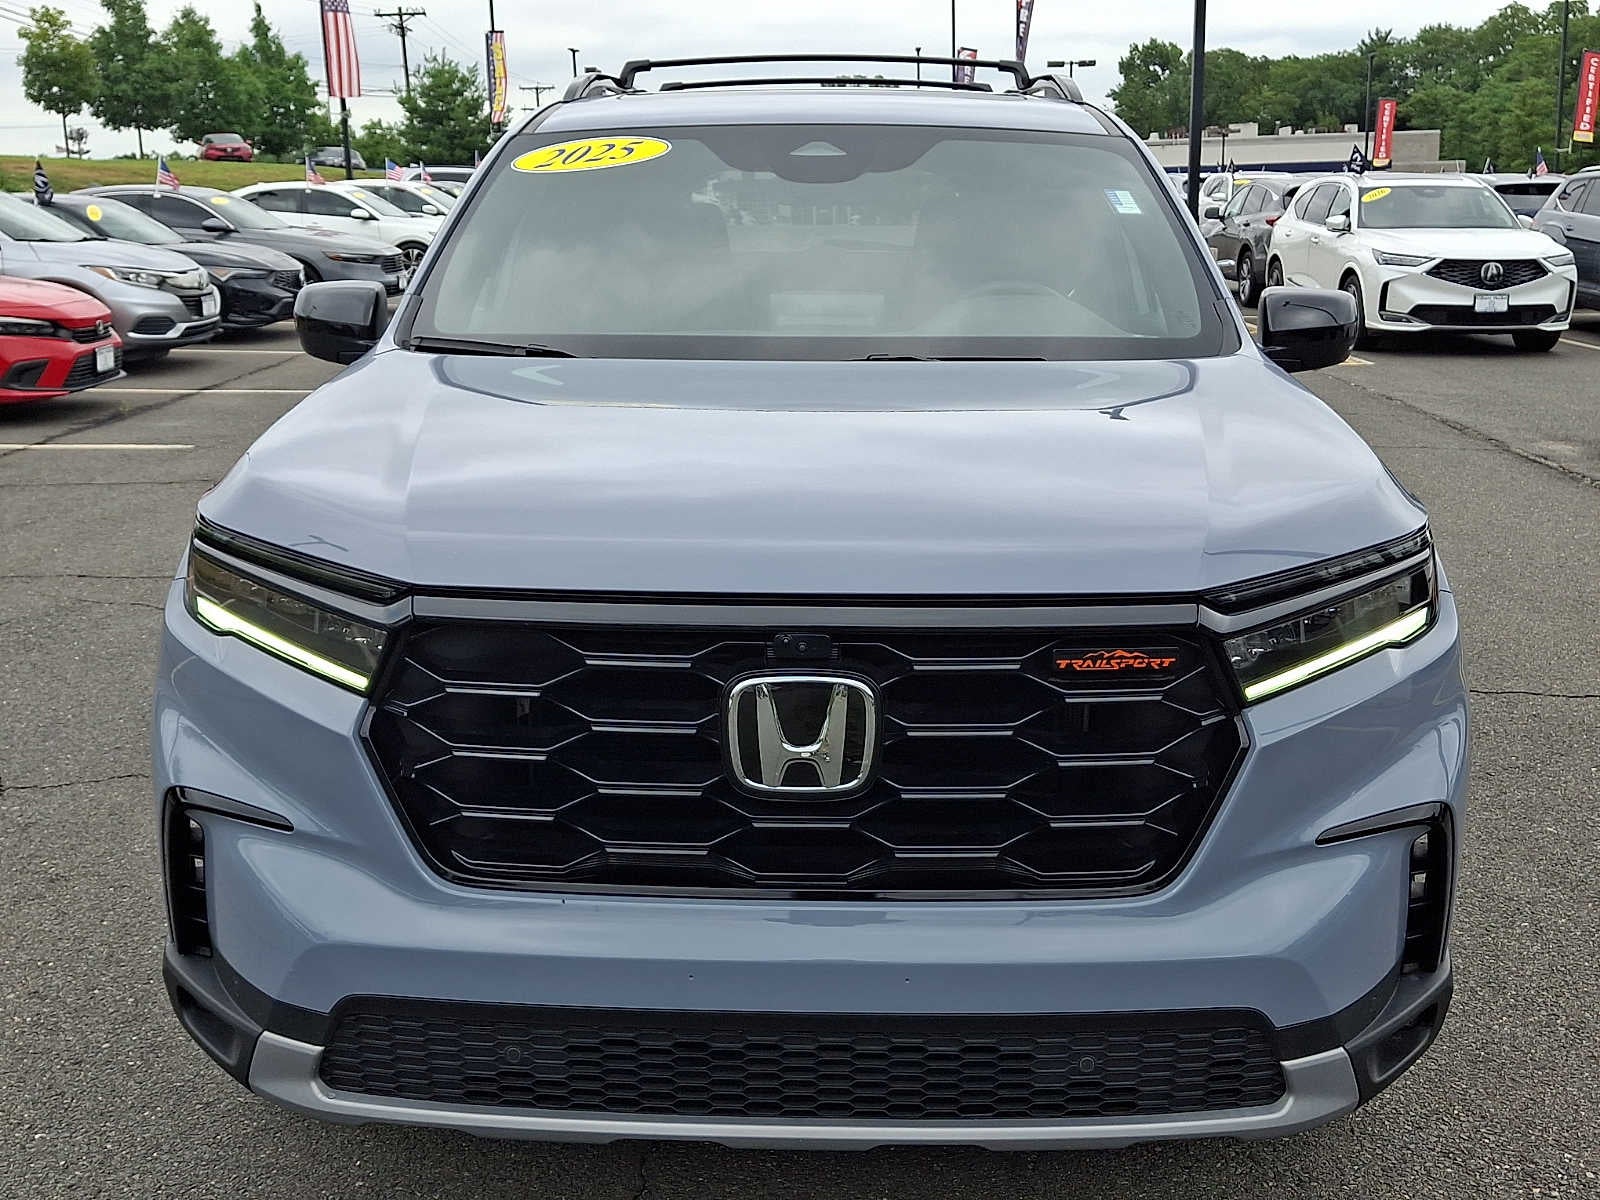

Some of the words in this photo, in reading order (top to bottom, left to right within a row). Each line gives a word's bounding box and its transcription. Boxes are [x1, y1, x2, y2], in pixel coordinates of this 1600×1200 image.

[1580, 58, 1600, 131] CERTIFIED
[533, 141, 644, 169] 2025
[1055, 658, 1177, 671] TRAILSPORT
